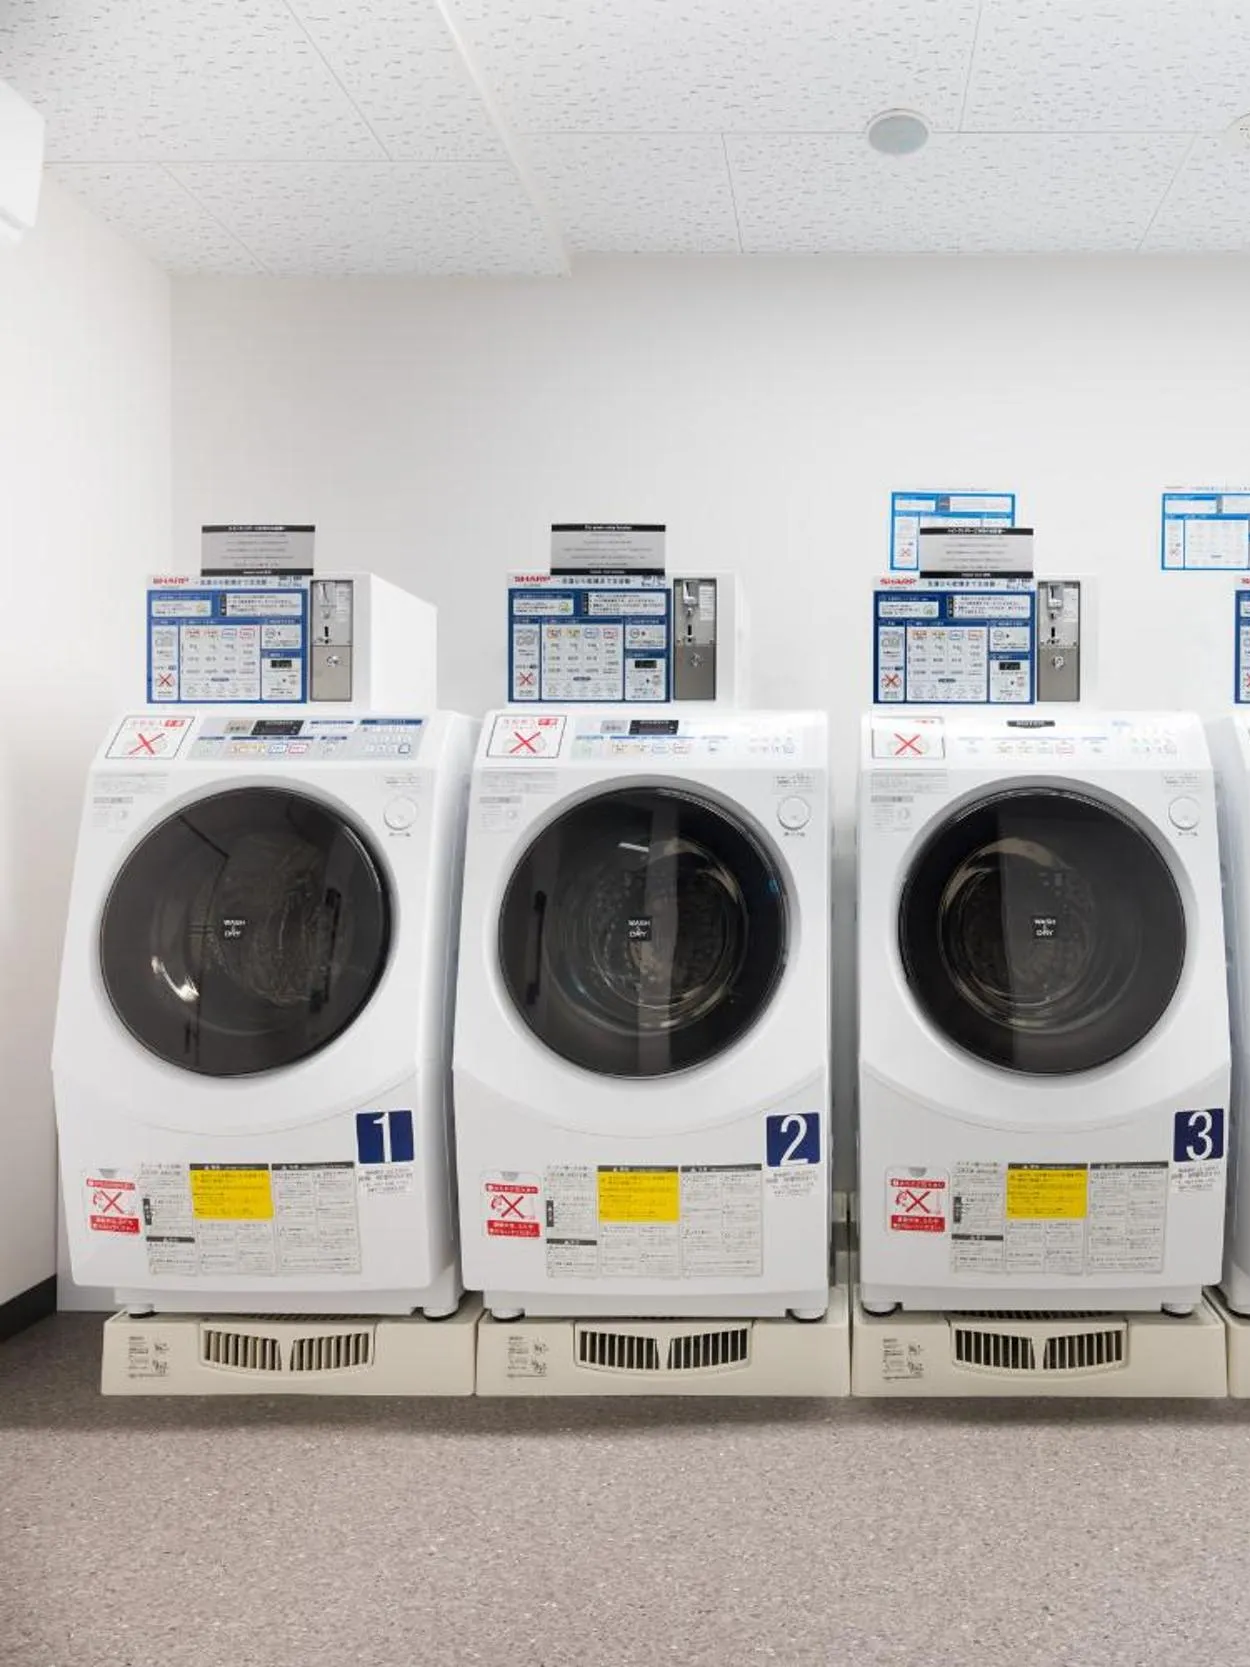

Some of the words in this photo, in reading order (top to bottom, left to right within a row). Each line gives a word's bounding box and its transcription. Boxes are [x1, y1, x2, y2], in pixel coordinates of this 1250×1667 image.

[515, 575, 551, 583] SHARP
[879, 578, 917, 586] SHARP
[373, 1111, 392, 1163] 1
[779, 1113, 809, 1167] 2
[1185, 1111, 1213, 1162] 3
